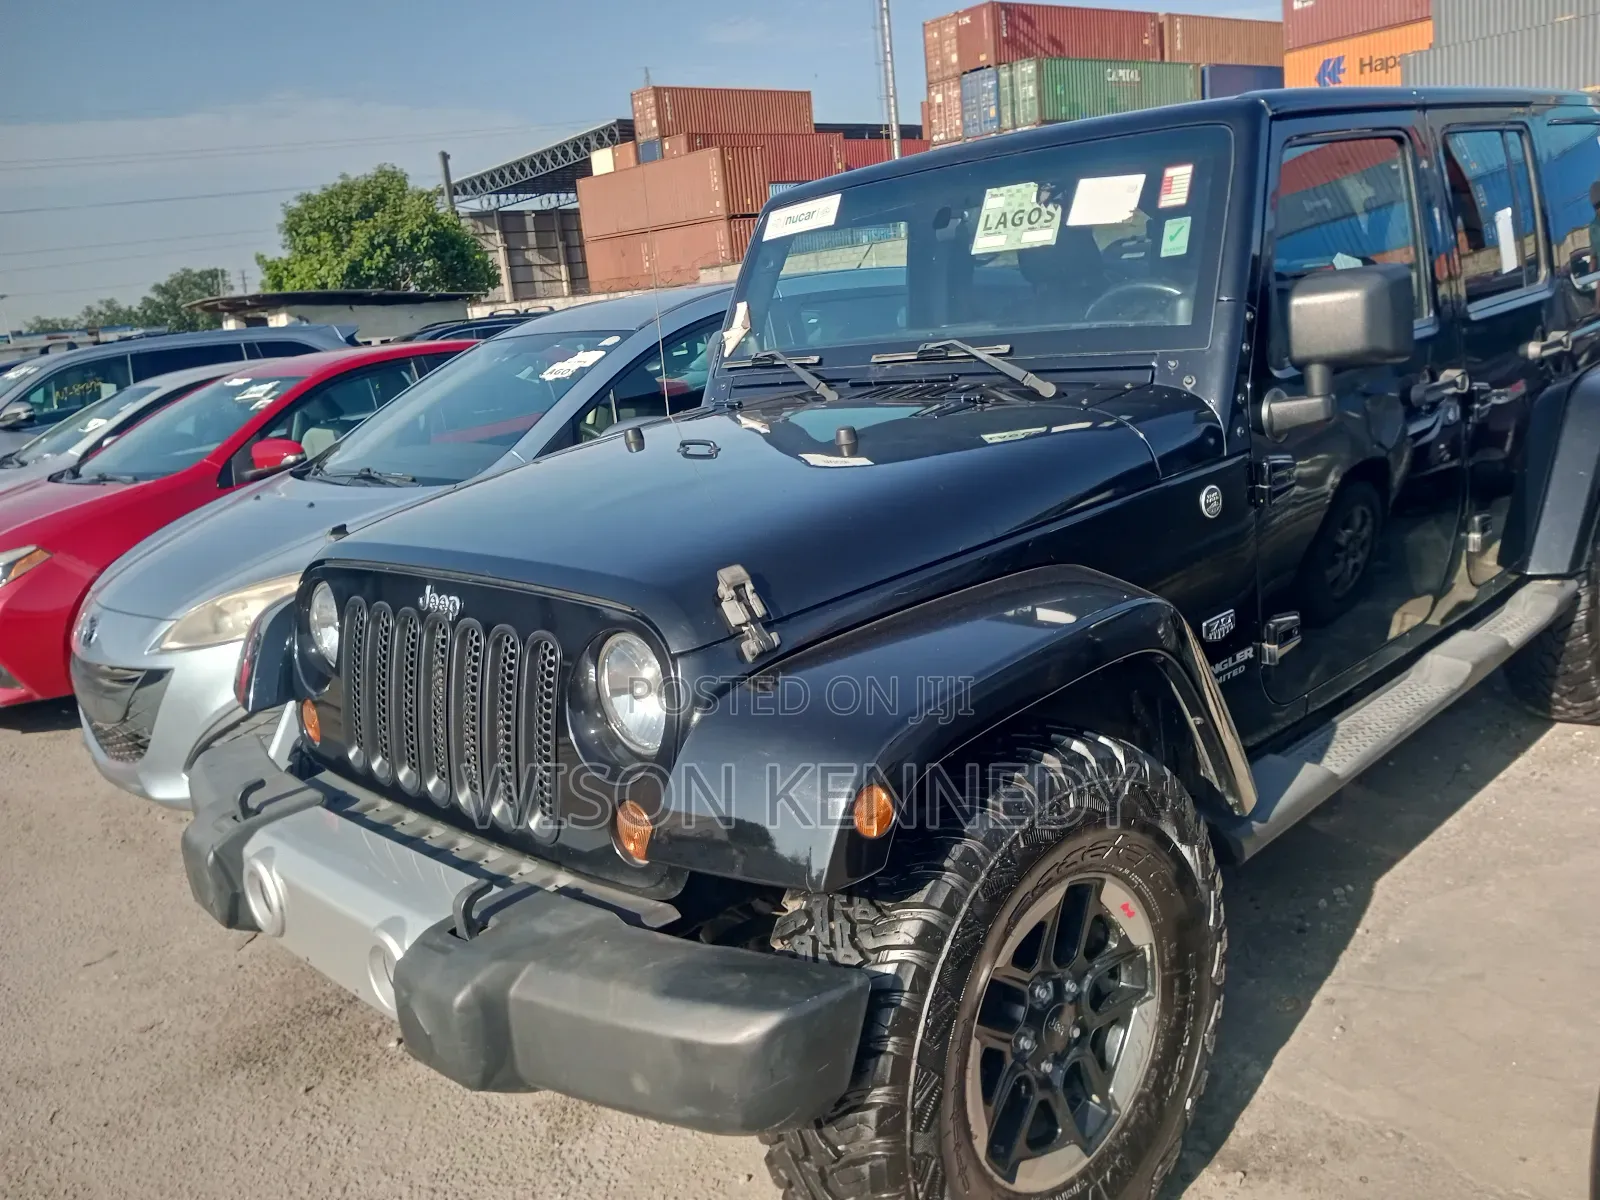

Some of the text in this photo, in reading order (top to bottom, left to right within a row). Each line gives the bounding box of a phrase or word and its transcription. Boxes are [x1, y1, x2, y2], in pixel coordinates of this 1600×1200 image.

[785, 209, 817, 226] nucar
[983, 206, 1056, 232] LAGOS
[418, 585, 462, 621] Jeep
[1211, 647, 1254, 675] NGLER
[1216, 665, 1246, 684] MITED
